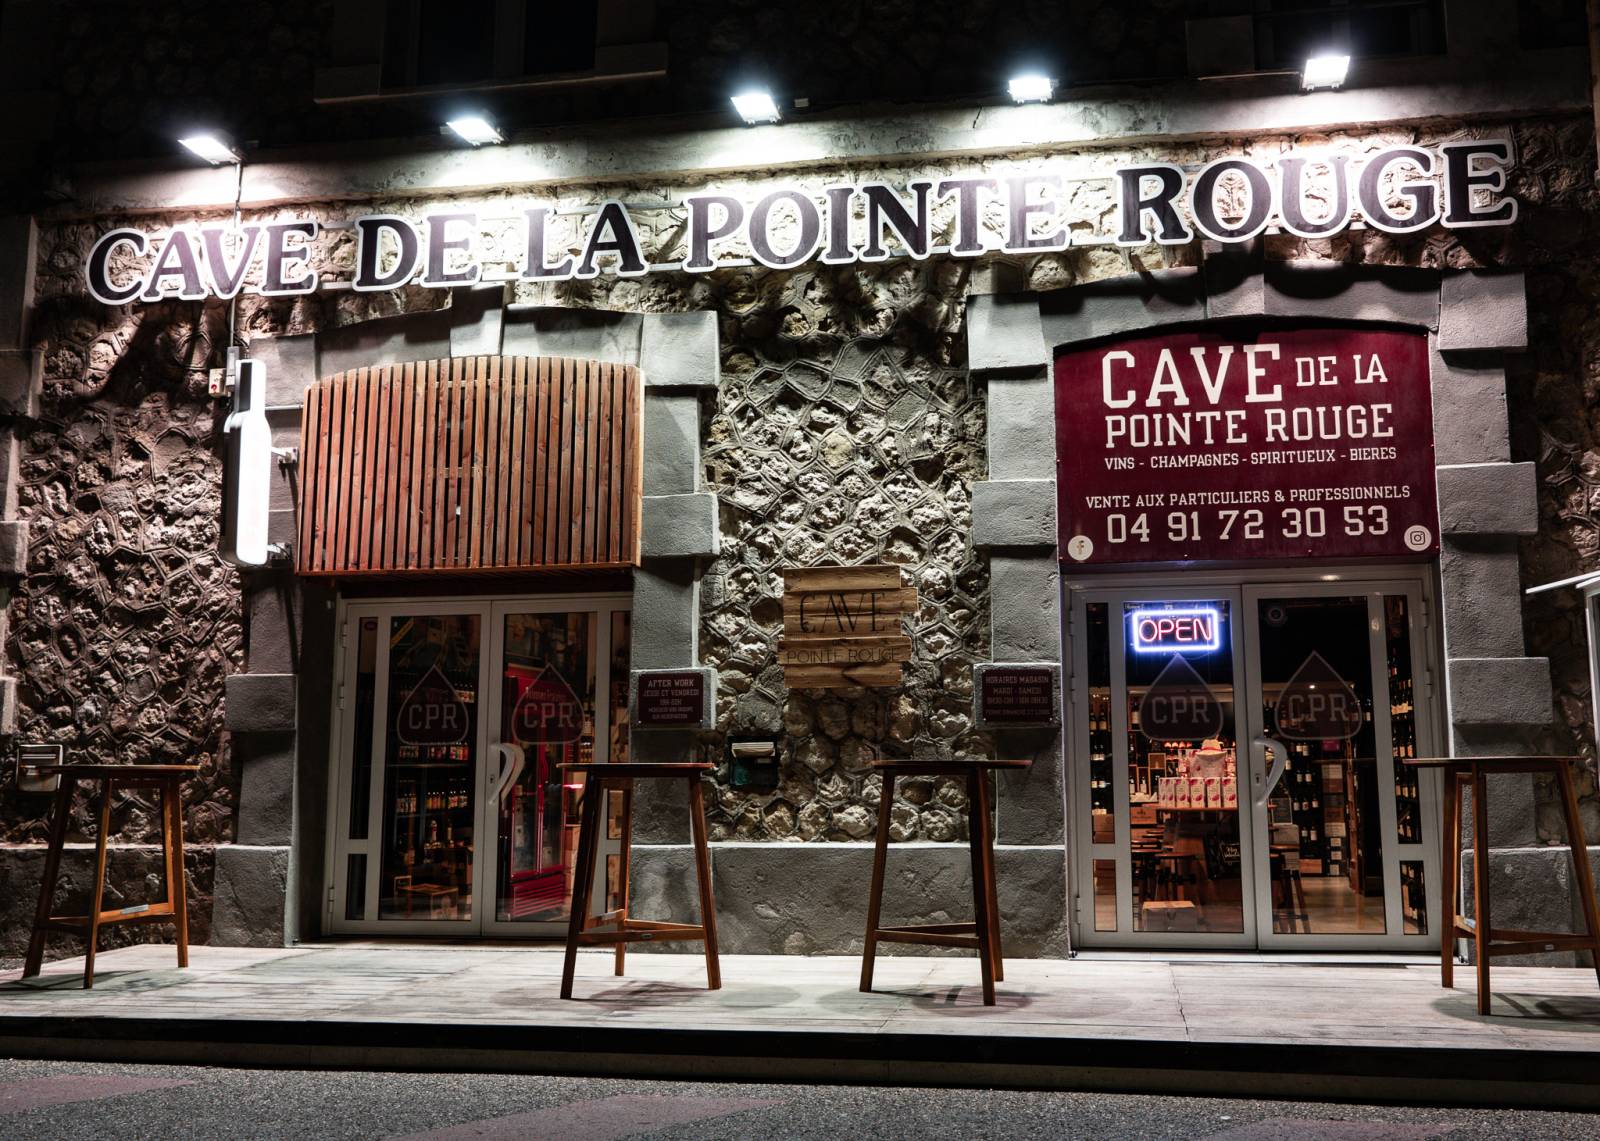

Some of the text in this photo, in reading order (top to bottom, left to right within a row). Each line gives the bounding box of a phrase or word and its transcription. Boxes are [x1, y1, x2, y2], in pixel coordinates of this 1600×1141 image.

[87, 140, 1517, 303] CAVE DE LA POINTE ROUGE
[1101, 342, 1389, 409] CAVE DE LA
[1104, 403, 1394, 449] POINTE ROUGE
[1104, 456, 1136, 471] VINS
[1150, 452, 1240, 469] CHAMPAGNES
[1250, 448, 1336, 466] SPIRITUEUX
[1349, 446, 1398, 462] BIERES
[1085, 485, 1411, 510] VENTE AUX PARTICULIERS & PROFESSIONNELS
[1107, 504, 1389, 544] 04 91 72 30 53
[799, 591, 886, 634] CAVE
[1138, 617, 1213, 643] OPEN
[786, 649, 842, 664] POINTE
[647, 679, 694, 688] AFTER WORK
[408, 703, 458, 730] CPR
[523, 702, 576, 729] CPR
[1151, 695, 1211, 724] CPR
[1288, 693, 1349, 722] CPR
